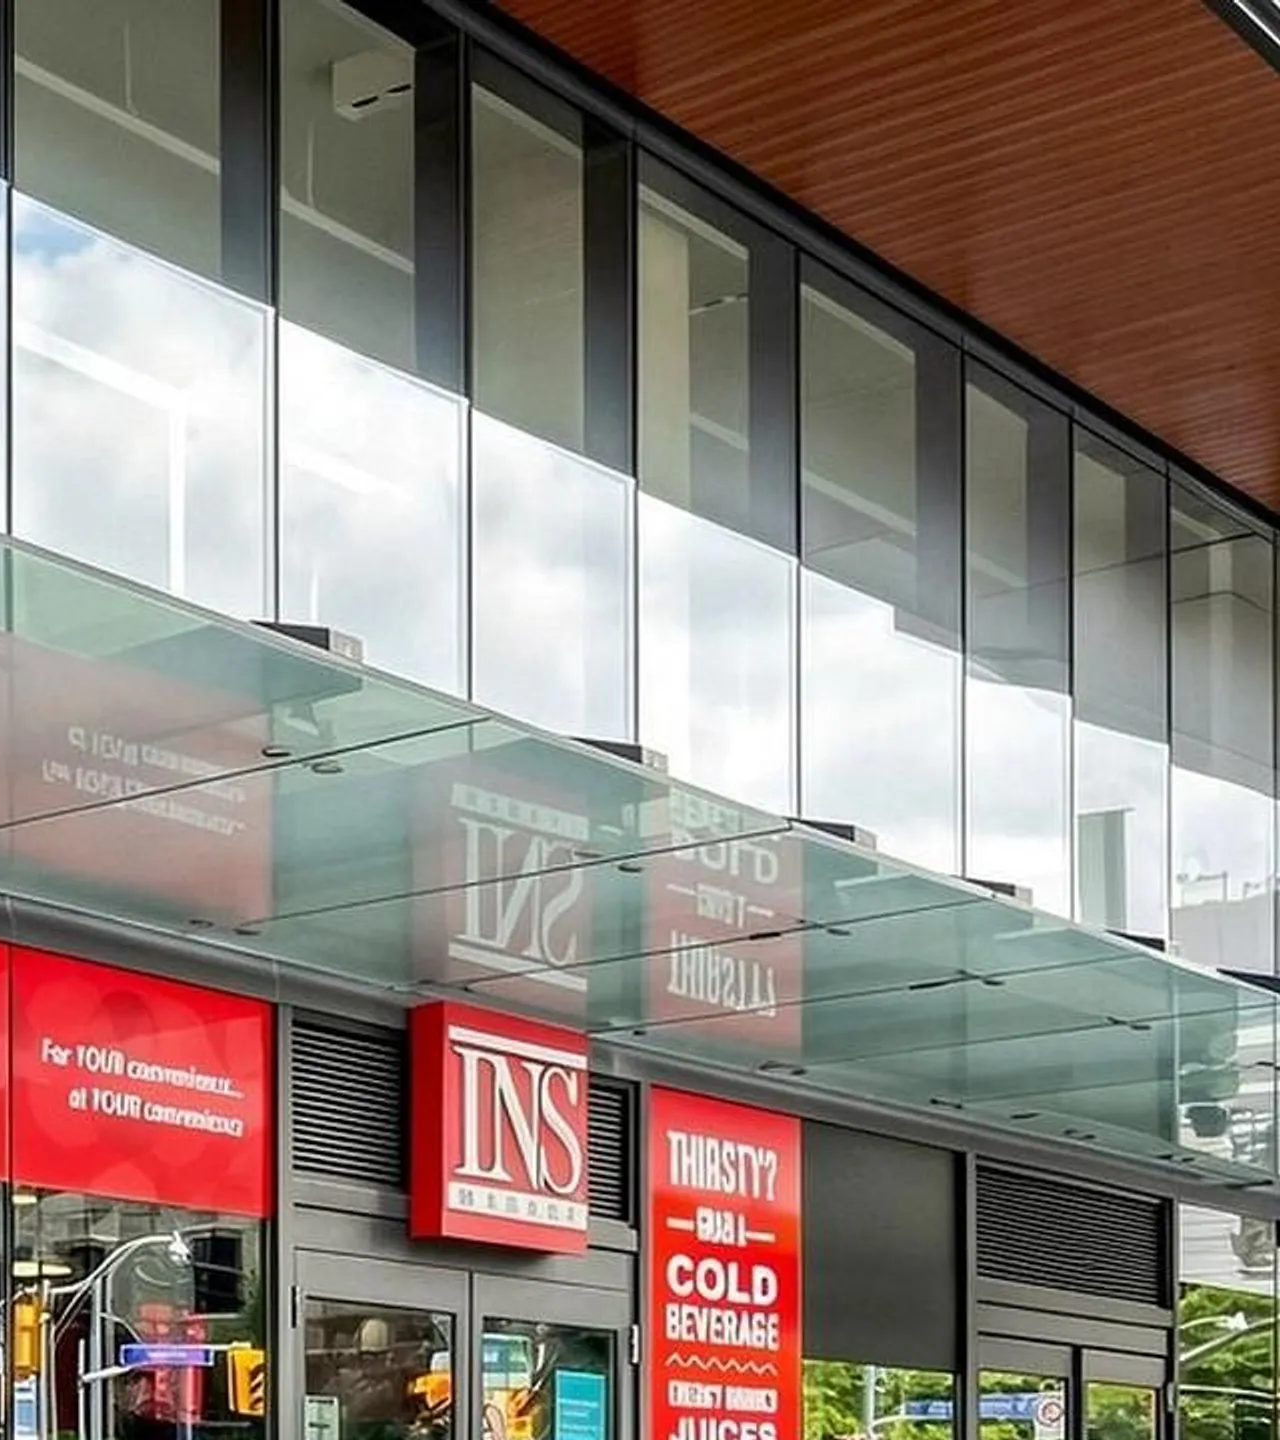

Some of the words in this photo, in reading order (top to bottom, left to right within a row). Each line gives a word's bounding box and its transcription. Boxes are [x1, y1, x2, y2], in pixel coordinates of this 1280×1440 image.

[452, 1045, 583, 1195] INS
[666, 1130, 778, 1201] THIRSTY?
[666, 1254, 778, 1306] COLD
[665, 1303, 780, 1351] BEVERAGE
